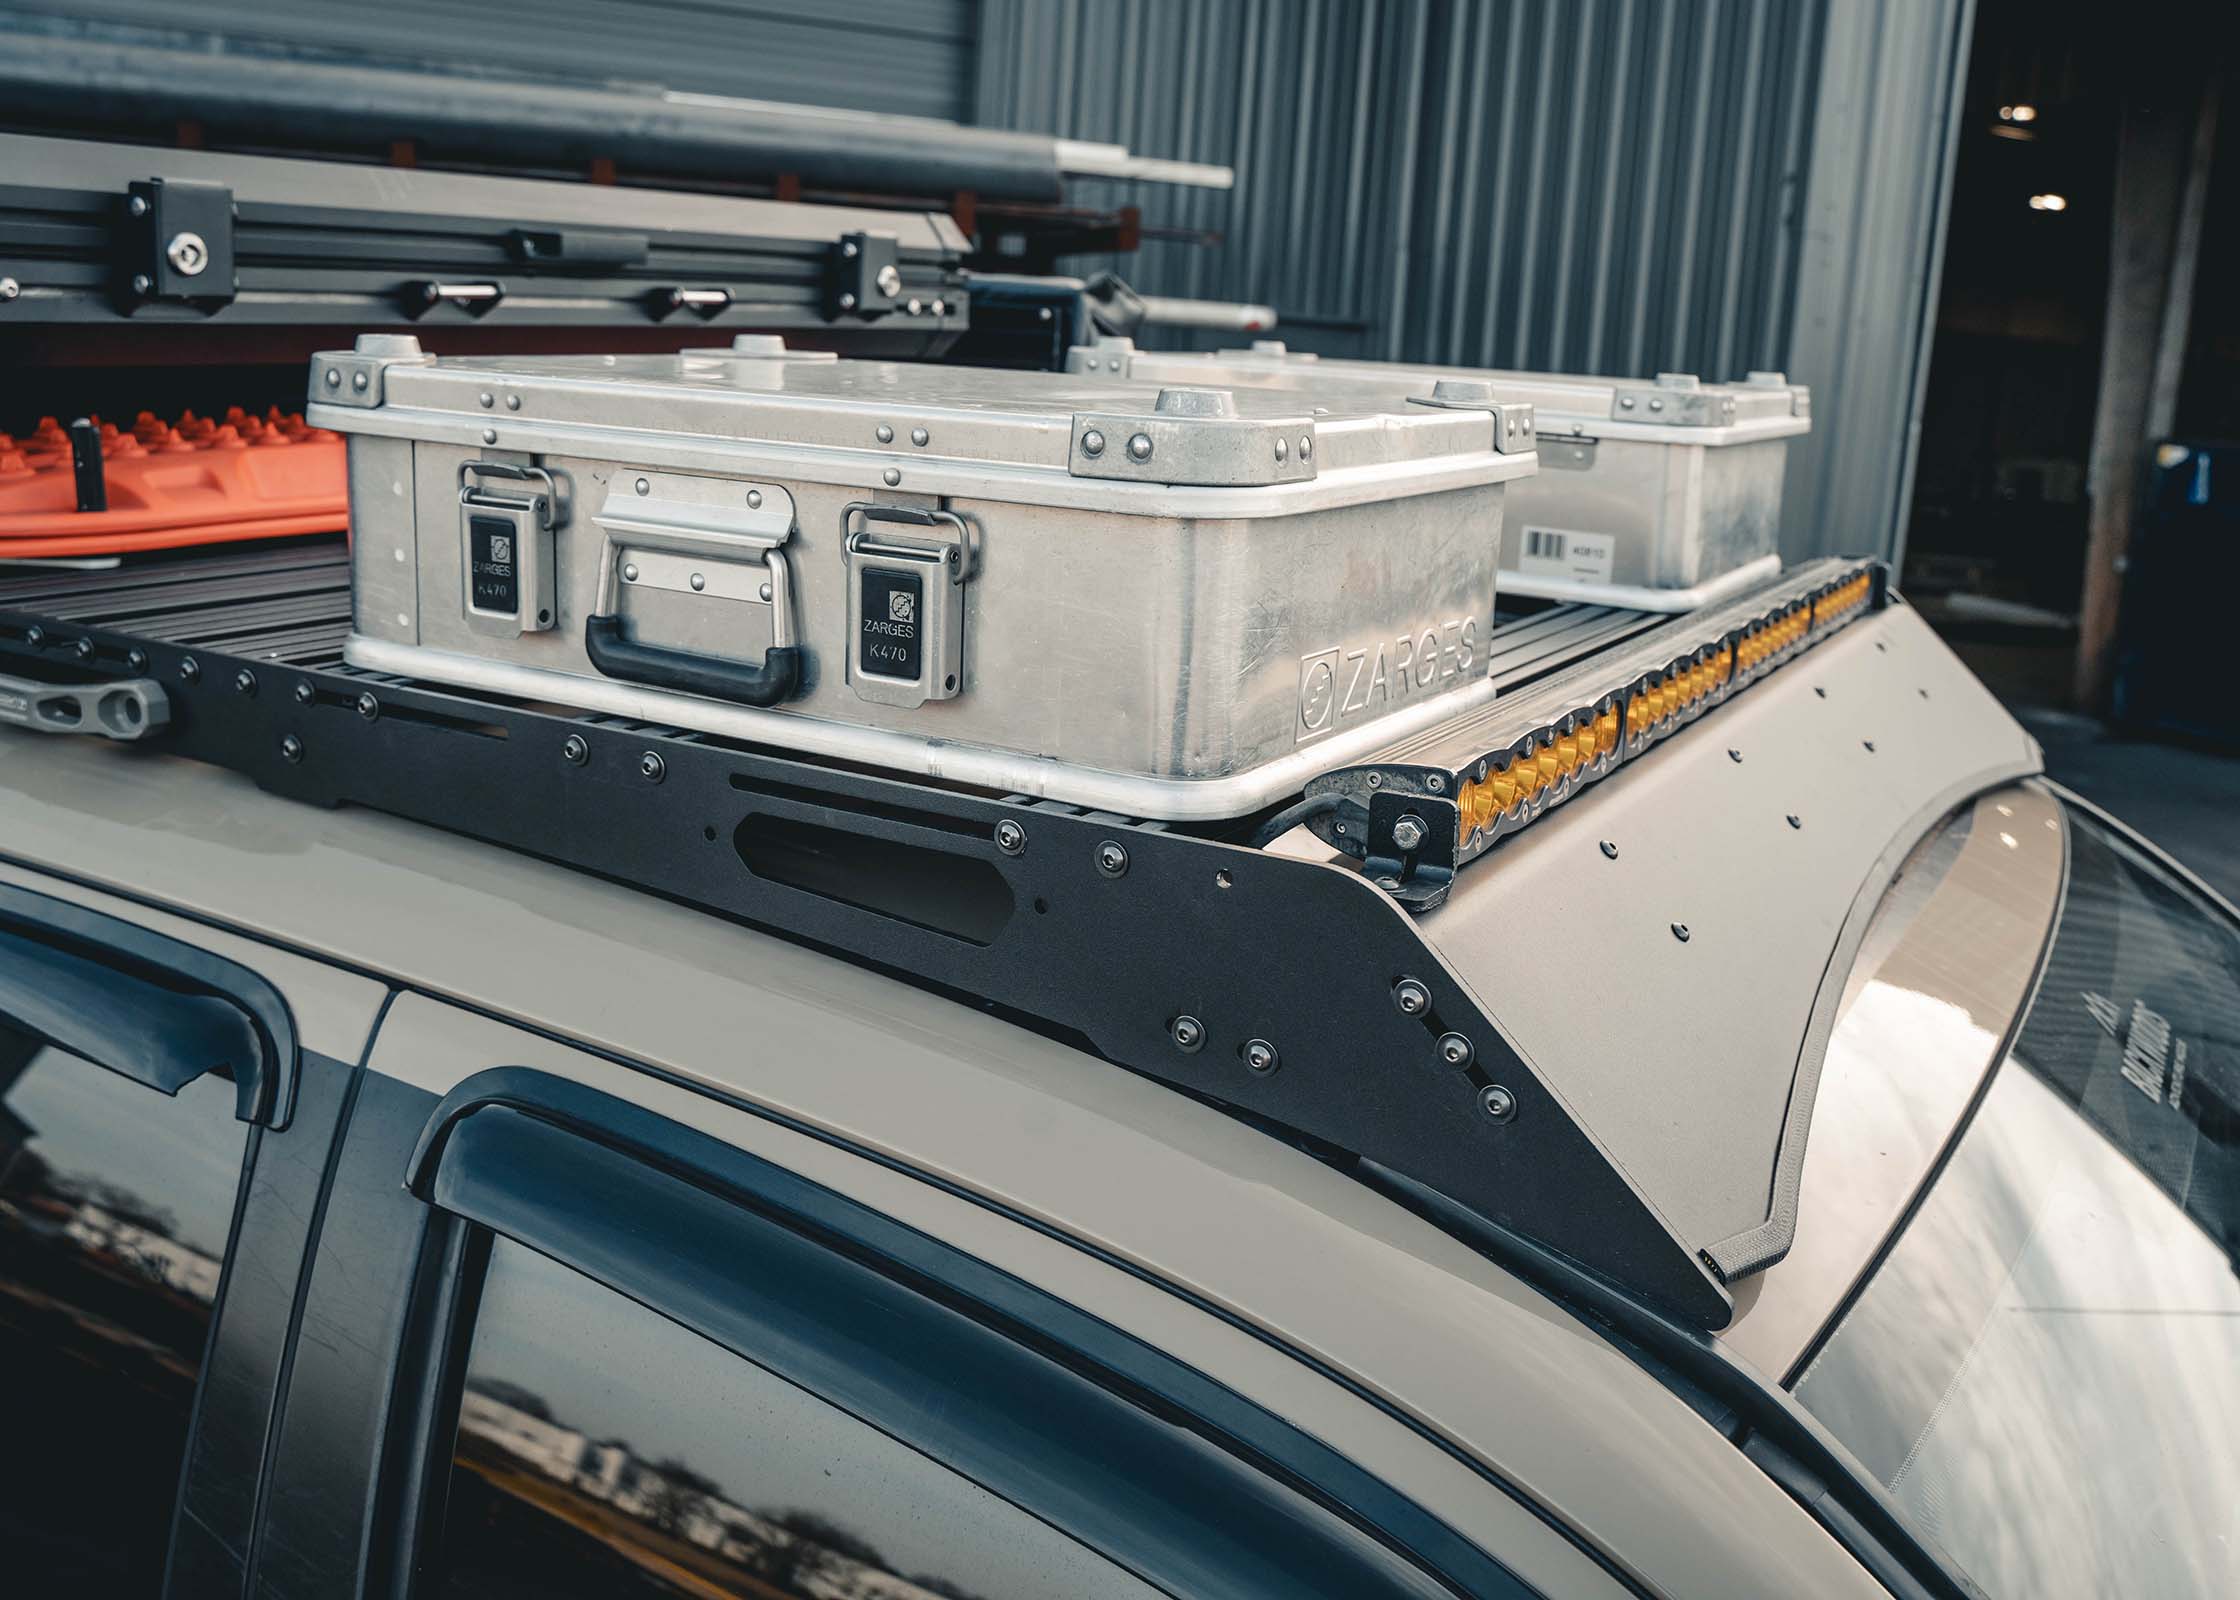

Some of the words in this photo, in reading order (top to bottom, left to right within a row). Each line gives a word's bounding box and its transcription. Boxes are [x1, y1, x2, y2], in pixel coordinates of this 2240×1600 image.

[864, 619, 914, 639] ZARGES
[870, 643, 907, 662] K470
[1341, 615, 1477, 718] ZARGES
